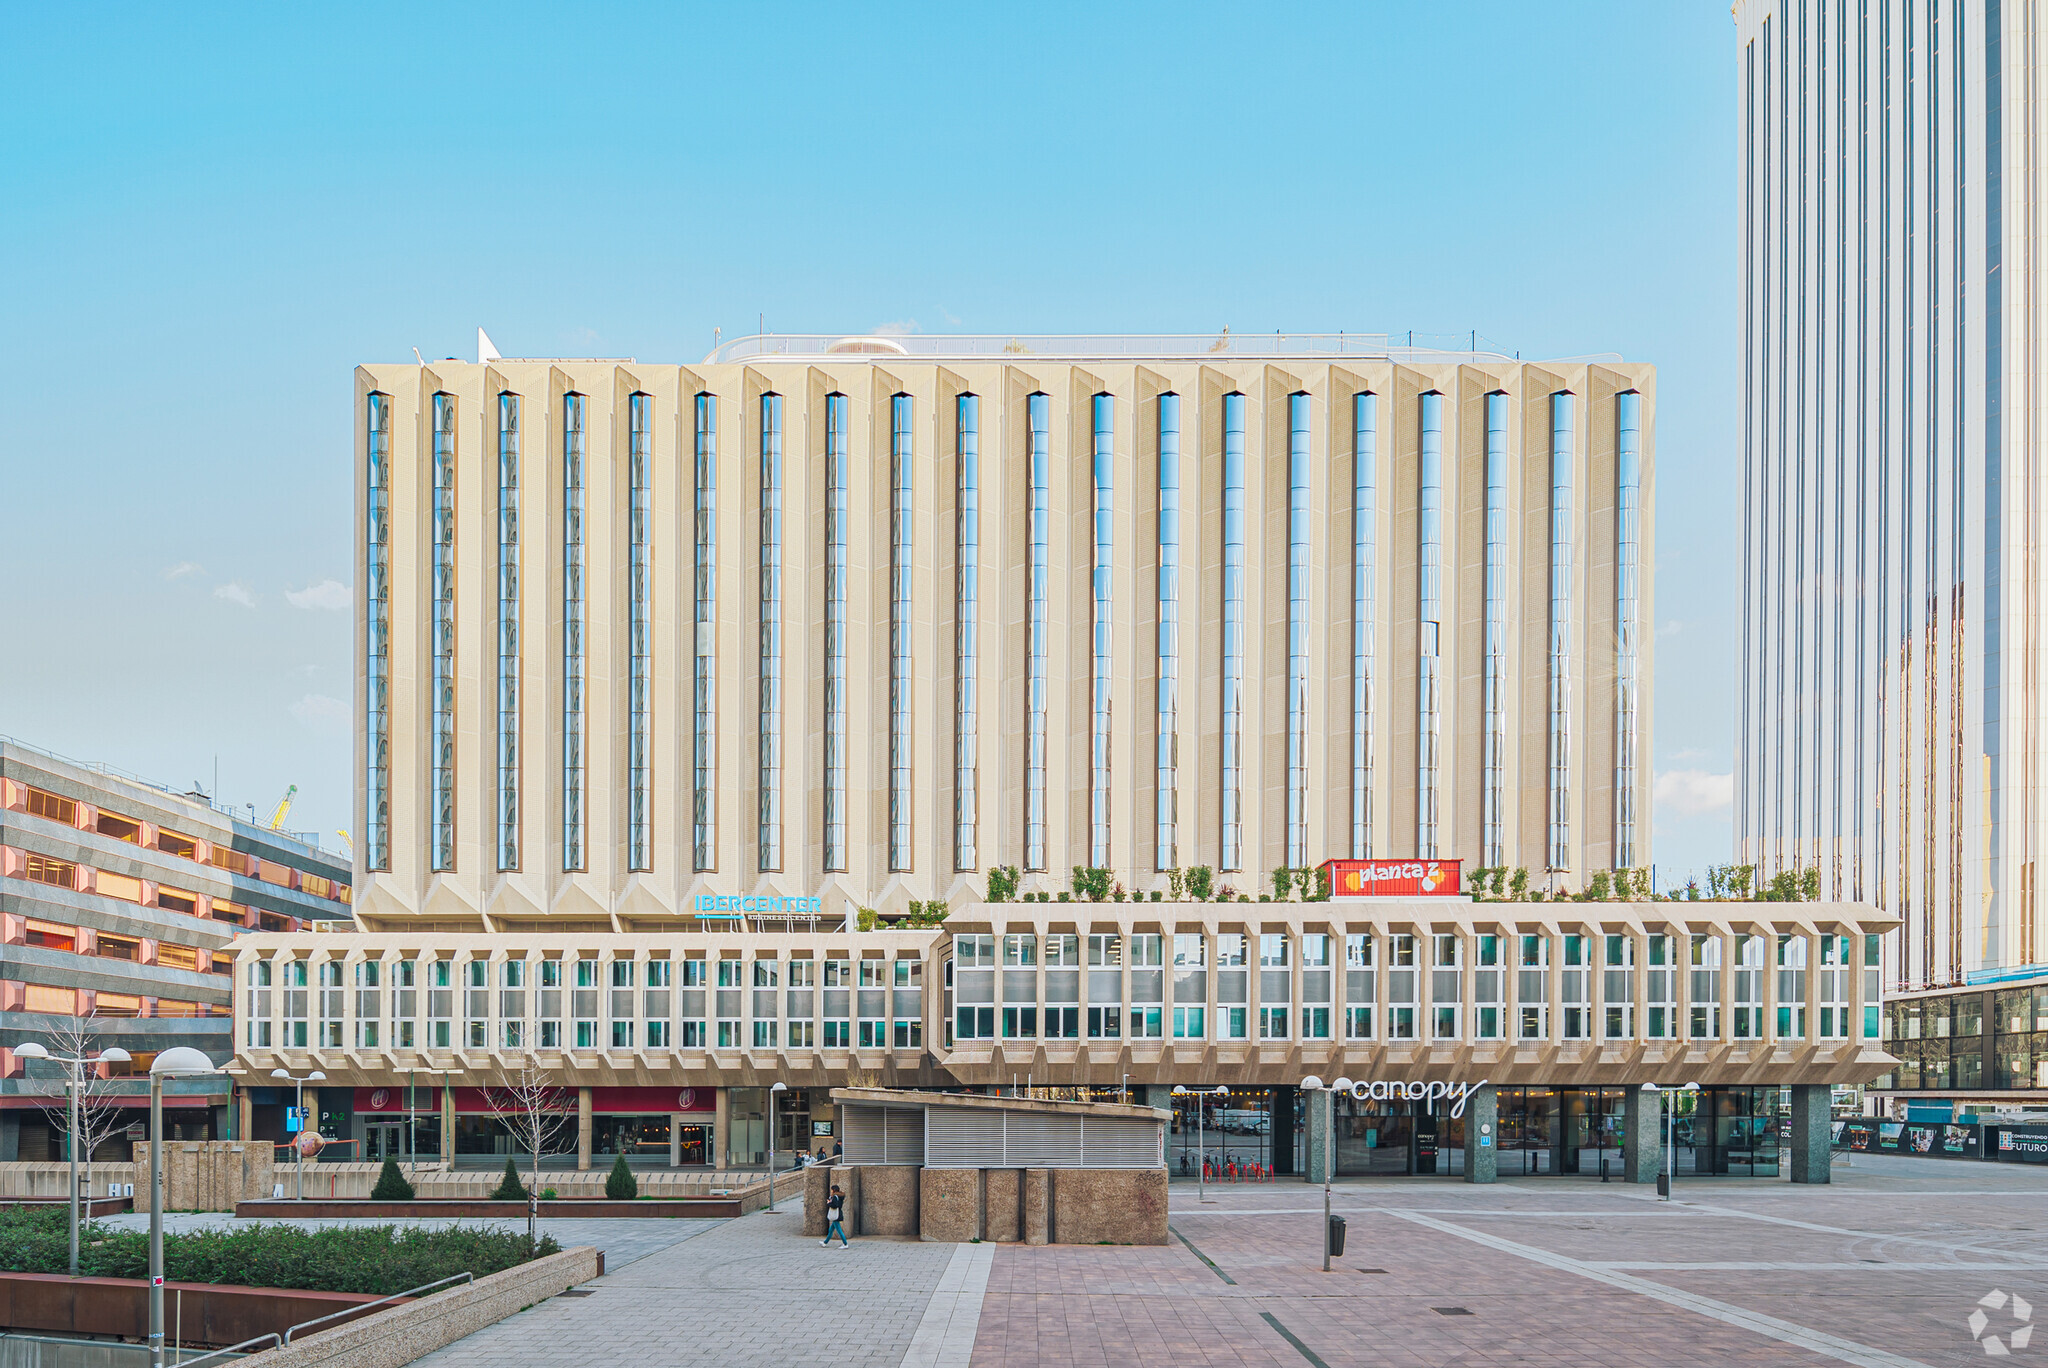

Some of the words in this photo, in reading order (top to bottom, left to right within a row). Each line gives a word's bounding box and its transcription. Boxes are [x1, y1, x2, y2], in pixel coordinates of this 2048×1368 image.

[1360, 863, 1423, 888] planta
[695, 895, 821, 912] IBERCENTER
[1351, 1079, 1488, 1119] canopy
[2011, 1143, 2048, 1152] FUTURO
